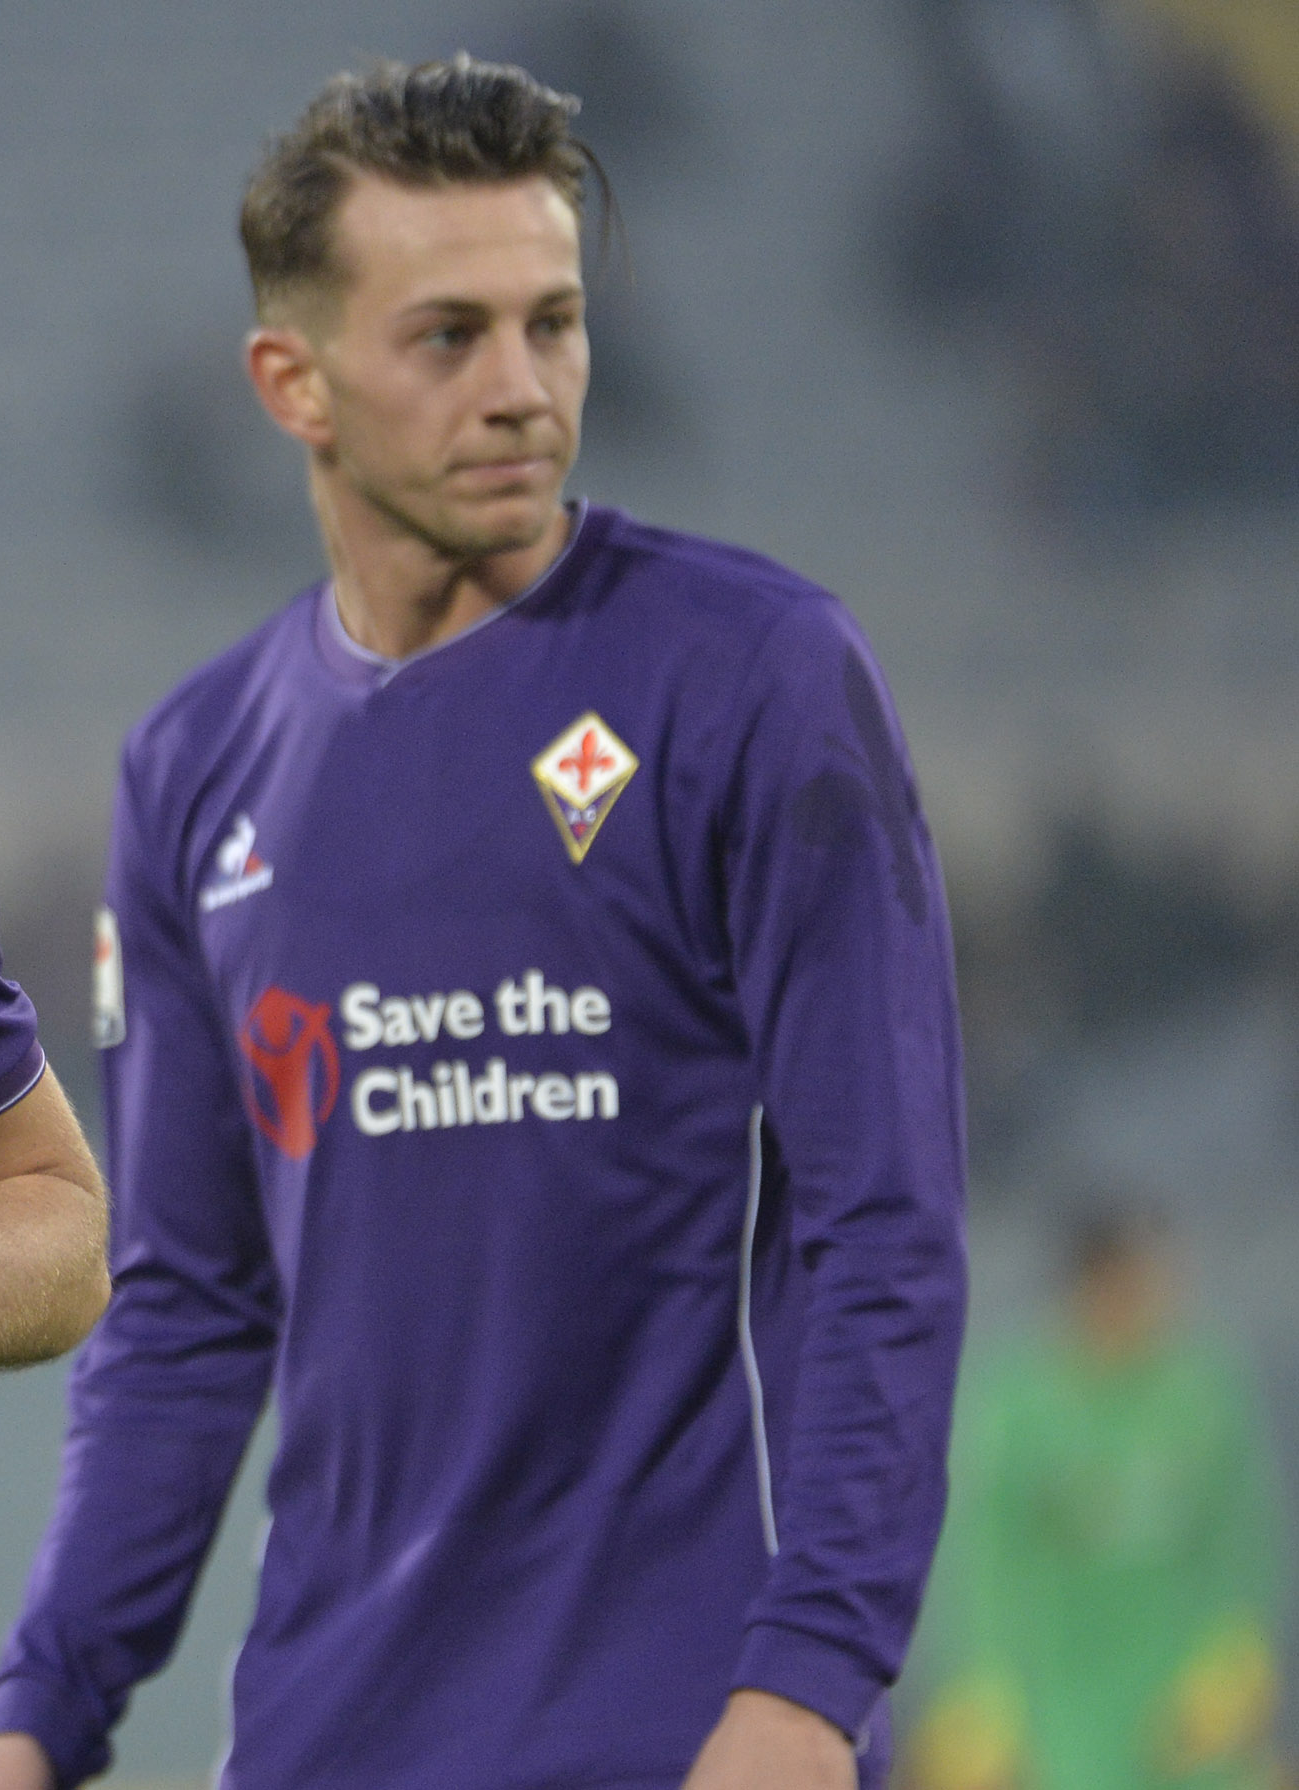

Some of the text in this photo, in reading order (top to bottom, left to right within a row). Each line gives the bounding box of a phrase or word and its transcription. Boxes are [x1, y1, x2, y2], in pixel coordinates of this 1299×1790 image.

[342, 967, 612, 1051] Save the
[353, 1056, 620, 1136] Children
